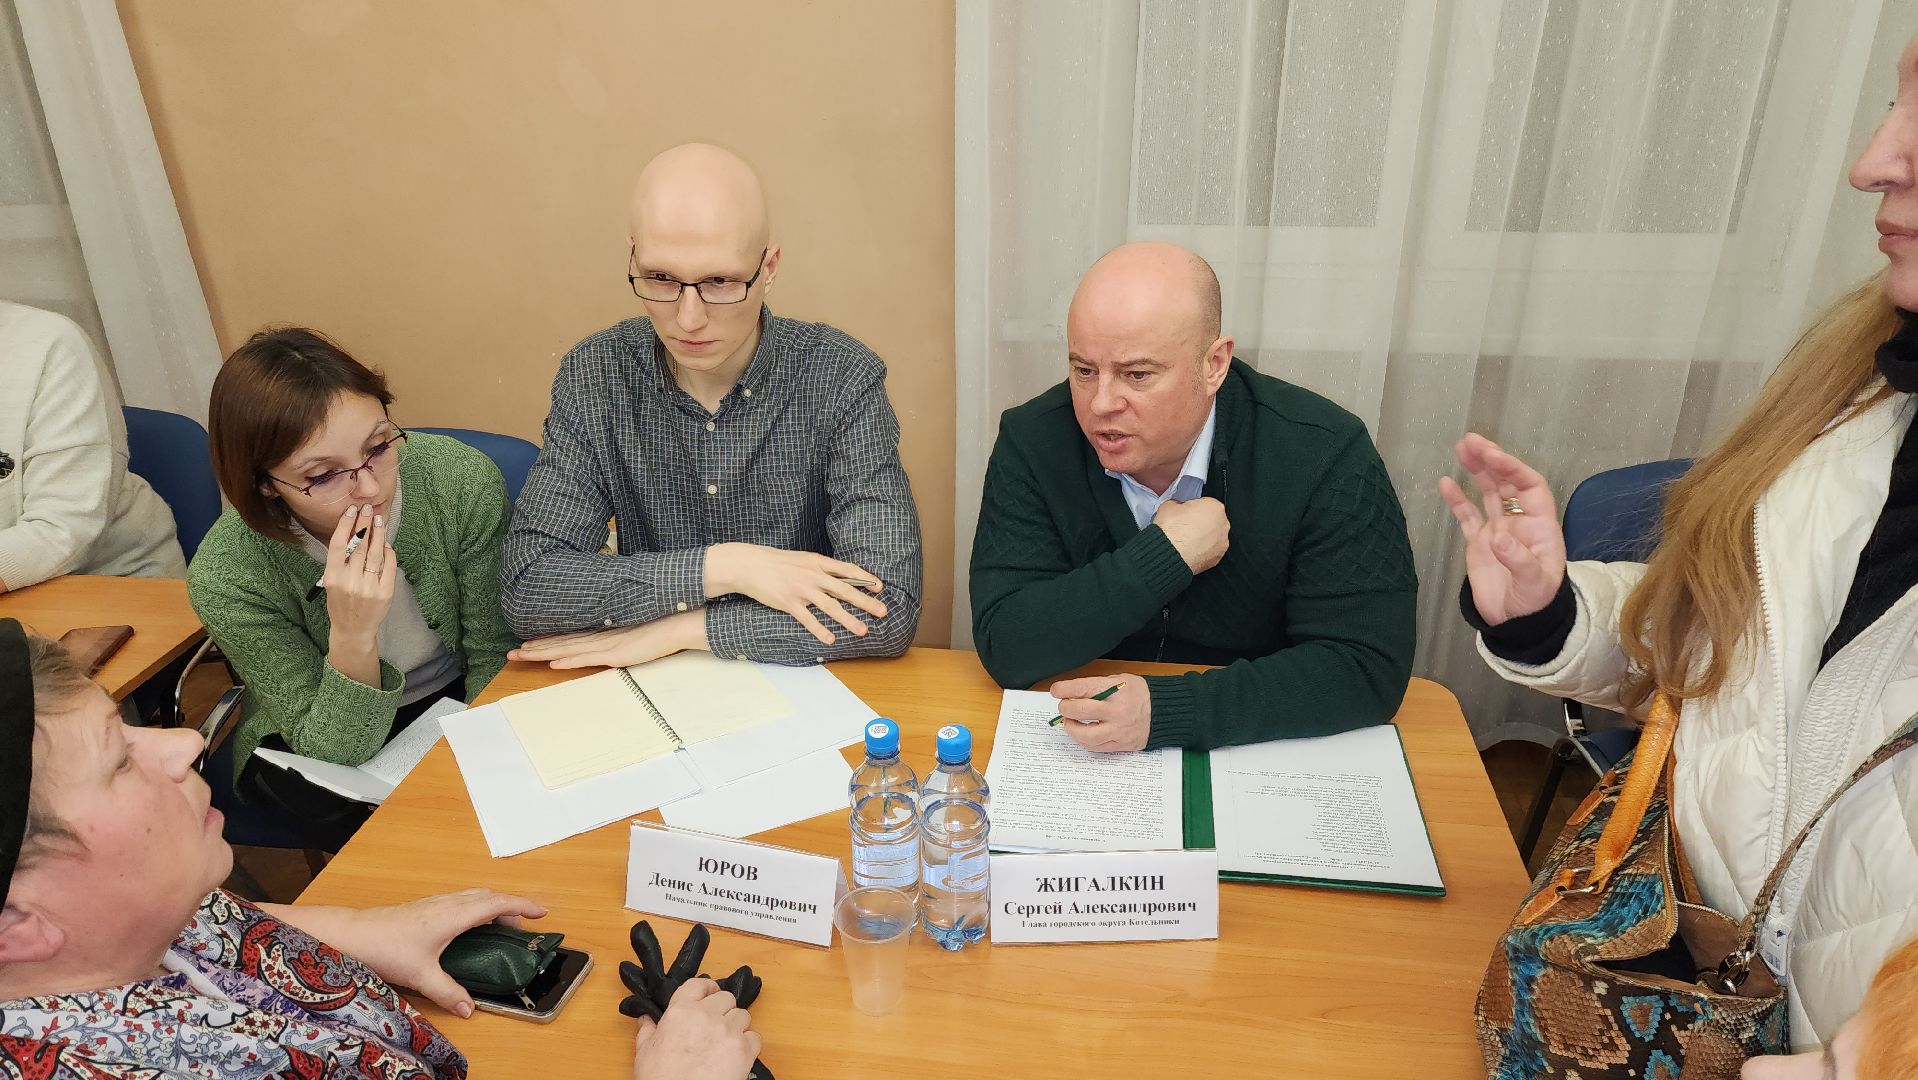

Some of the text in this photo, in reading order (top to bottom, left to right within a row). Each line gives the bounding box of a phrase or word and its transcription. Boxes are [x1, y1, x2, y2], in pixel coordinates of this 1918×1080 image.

[698, 856, 758, 881] ЮРОВ
[648, 872, 818, 914] Денис Александрович
[1035, 875, 1166, 892] ЖИГАЛКИН
[1004, 901, 1197, 918] Сергей Александрович
